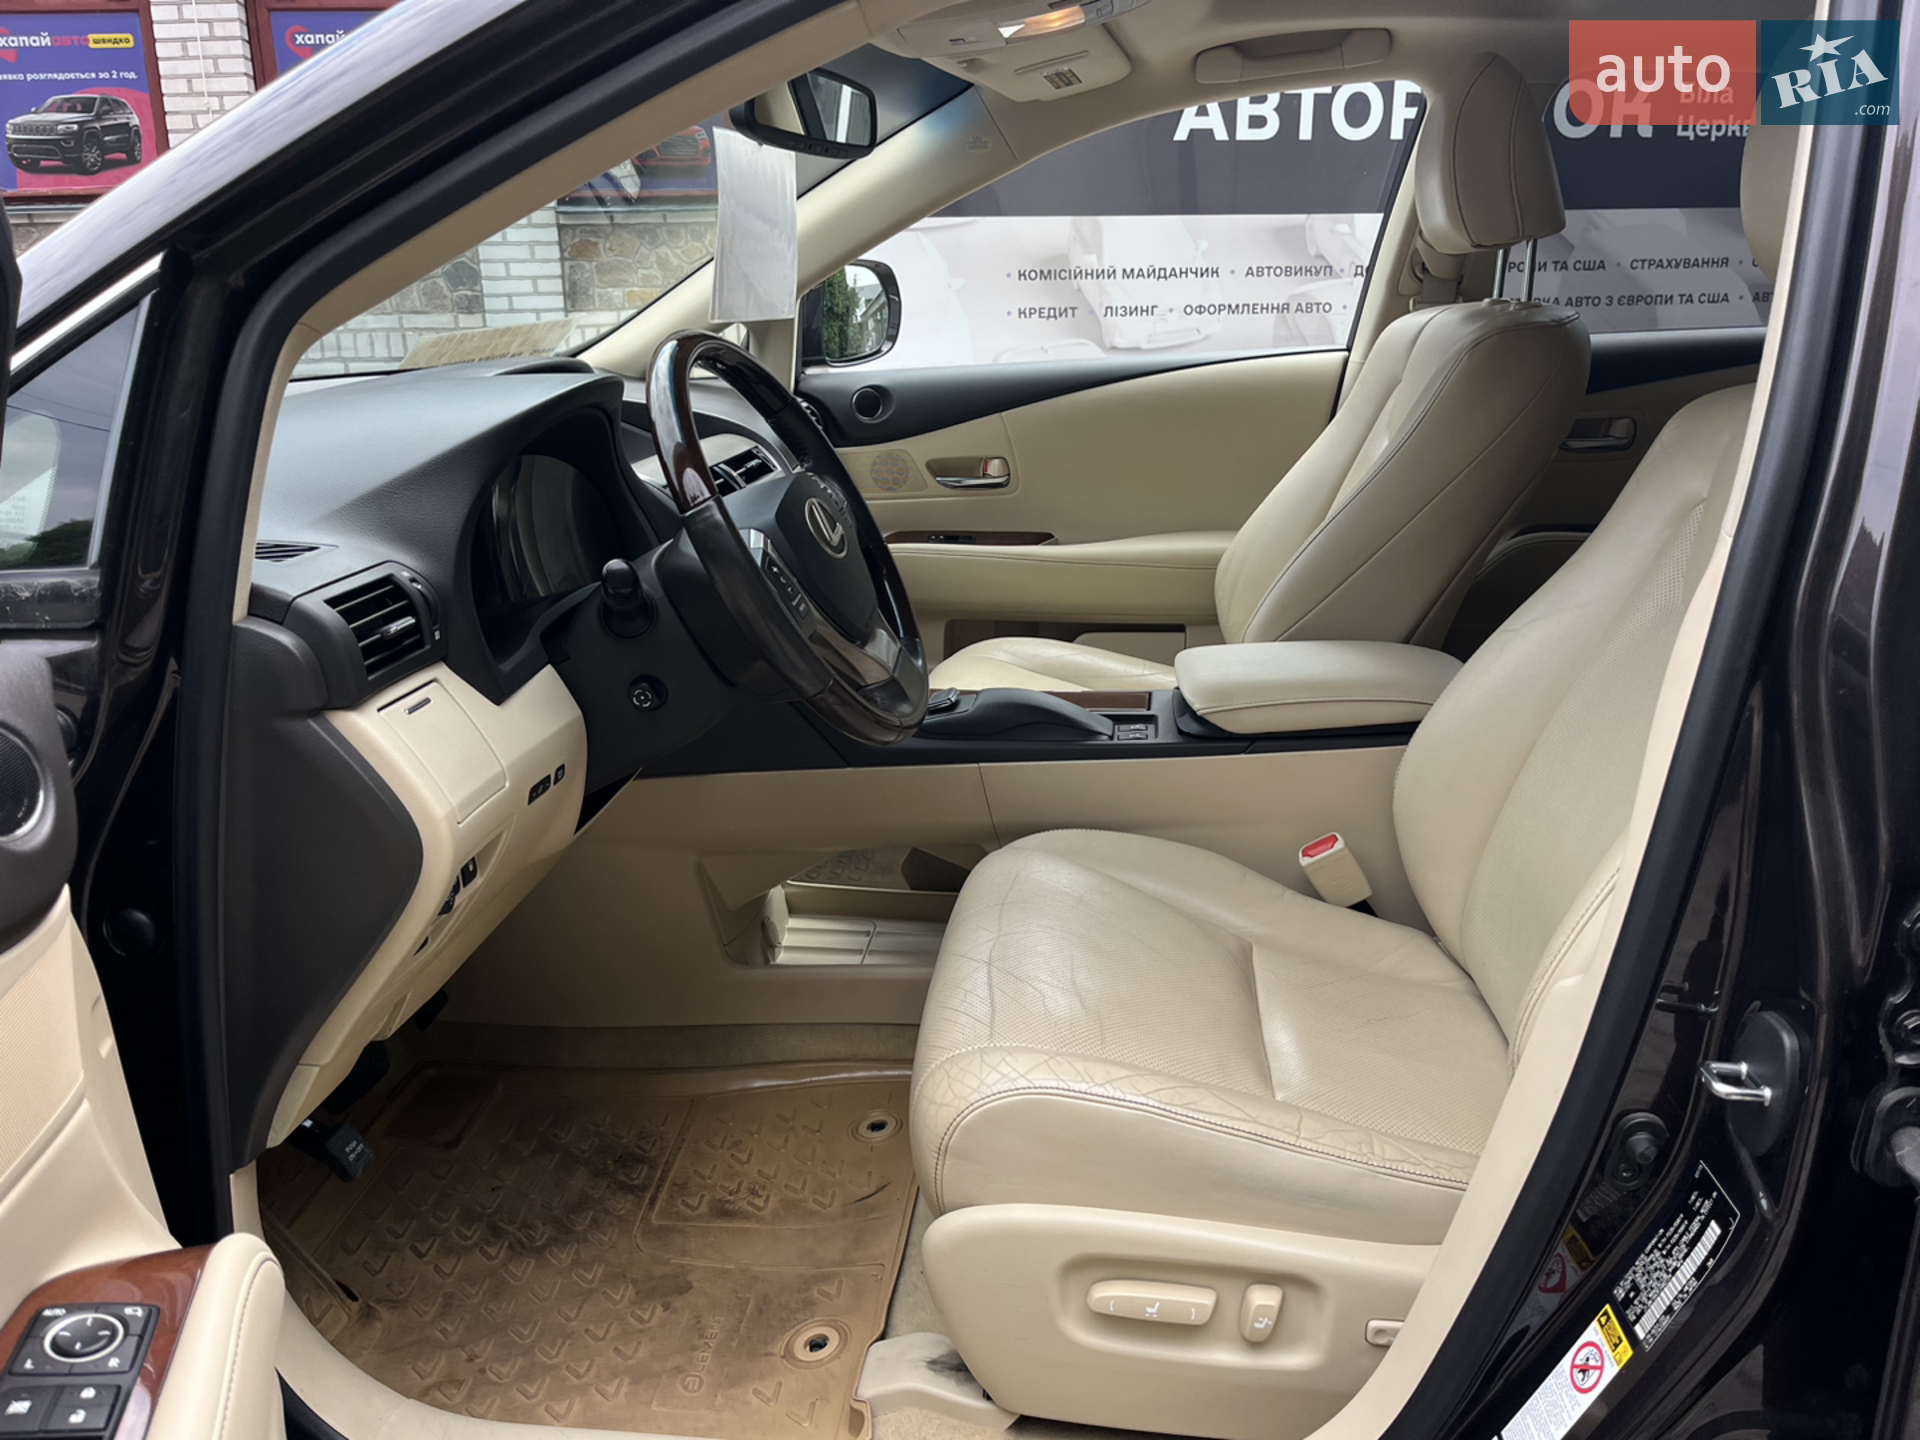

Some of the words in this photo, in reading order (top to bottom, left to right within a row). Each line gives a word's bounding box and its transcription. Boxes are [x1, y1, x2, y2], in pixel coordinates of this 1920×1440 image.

[92, 37, 131, 45] швидко
[26, 72, 96, 82] розглядається
[111, 70, 118, 79] 2
[1552, 261, 1569, 272] ТА
[1573, 260, 1606, 271] США
[1630, 257, 1730, 270] СТРАХУВАННЯ
[1018, 266, 1117, 281] КОМІСІЙНИЙ
[1122, 265, 1220, 281] МАЙДАНЧИК
[1244, 264, 1334, 278] АВТОВИКУП
[1564, 295, 1602, 308] АВТО
[1617, 294, 1675, 307] ЄВРОПИ
[1678, 293, 1695, 306] ТА
[1697, 292, 1731, 305] США
[1018, 306, 1079, 321] КРЕДИТ
[1103, 305, 1158, 318] ЛІЗИНГ
[1183, 303, 1290, 316] ОФОРМЛЕННЯ
[1294, 302, 1333, 314] АВТО
